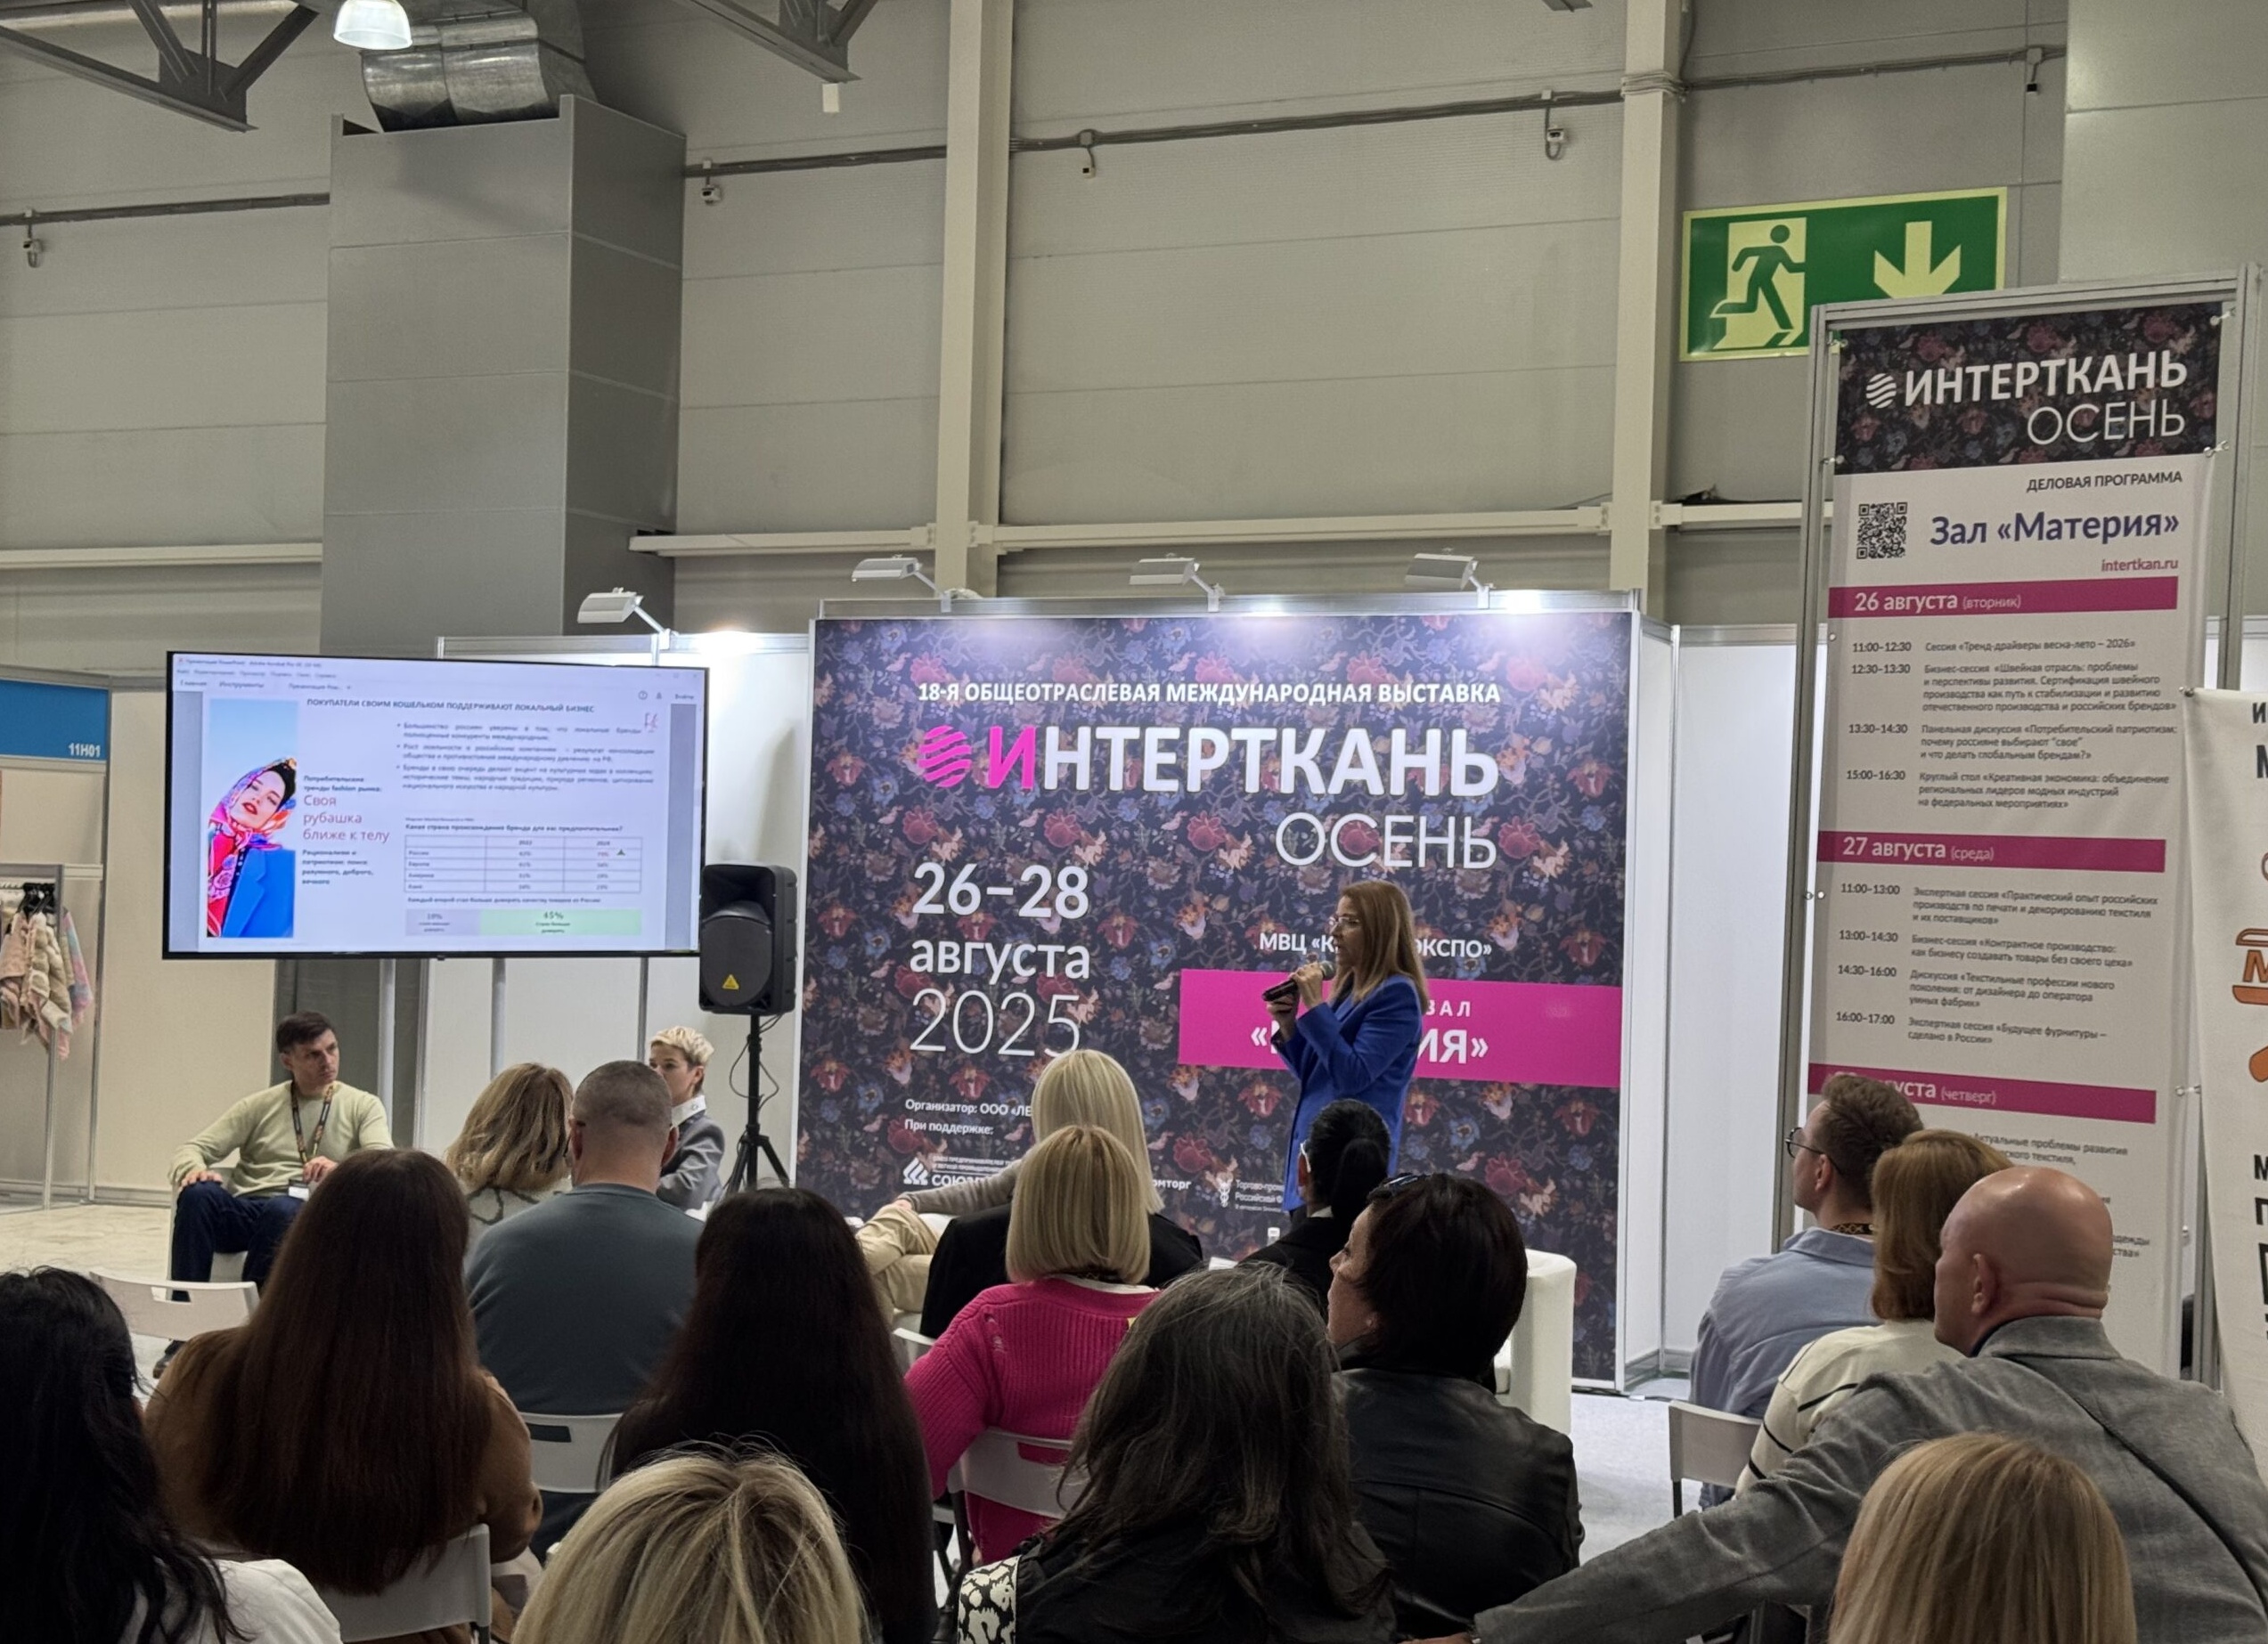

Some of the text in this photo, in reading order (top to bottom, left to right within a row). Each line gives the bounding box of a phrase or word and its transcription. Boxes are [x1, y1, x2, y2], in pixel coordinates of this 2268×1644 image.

[1905, 350, 2188, 406] ИНТЕРТКАНЬ
[2027, 398, 2186, 445] ОСЕНЬ
[2026, 470, 2182, 493] ДЕЛОВАЯ ПРОГРАММА
[1929, 511, 2180, 546] Зал «Материя»
[2101, 558, 2179, 572] intertkan.ru
[1854, 592, 2021, 614] 26 августа (вторник)
[306, 698, 359, 706] ПОКУПАТЕЛИ
[446, 702, 512, 711] ПОДДЕРЖИВАЮТ
[514, 703, 563, 711] ЛОКАЛЬНЫЙ
[918, 682, 1501, 706] 18-Я ОБЩЕОТРАСЛЕВАЯ МЕЖДУНАРОДНАЯ ВЫСТАВКА
[68, 743, 101, 757] 11H01
[986, 725, 1499, 796] ИНТЕРТКАНЬ
[304, 794, 337, 806] Своя
[303, 811, 363, 826] рубашка
[303, 828, 390, 843] ближе к телу
[1276, 812, 1497, 869] ОСЕНЬ
[1843, 836, 1995, 861] 27 августа (среда)
[1260, 932, 1308, 956] МВЦ
[910, 940, 1090, 985] августа
[1426, 999, 1471, 1017] ЗАЛ
[910, 988, 1080, 1057] 2025
[905, 1099, 977, 1115] Организатор:
[980, 1103, 1008, 1115] ООО
[1941, 1087, 1997, 1105] (четверг)
[904, 1119, 994, 1135] При поддержке:
